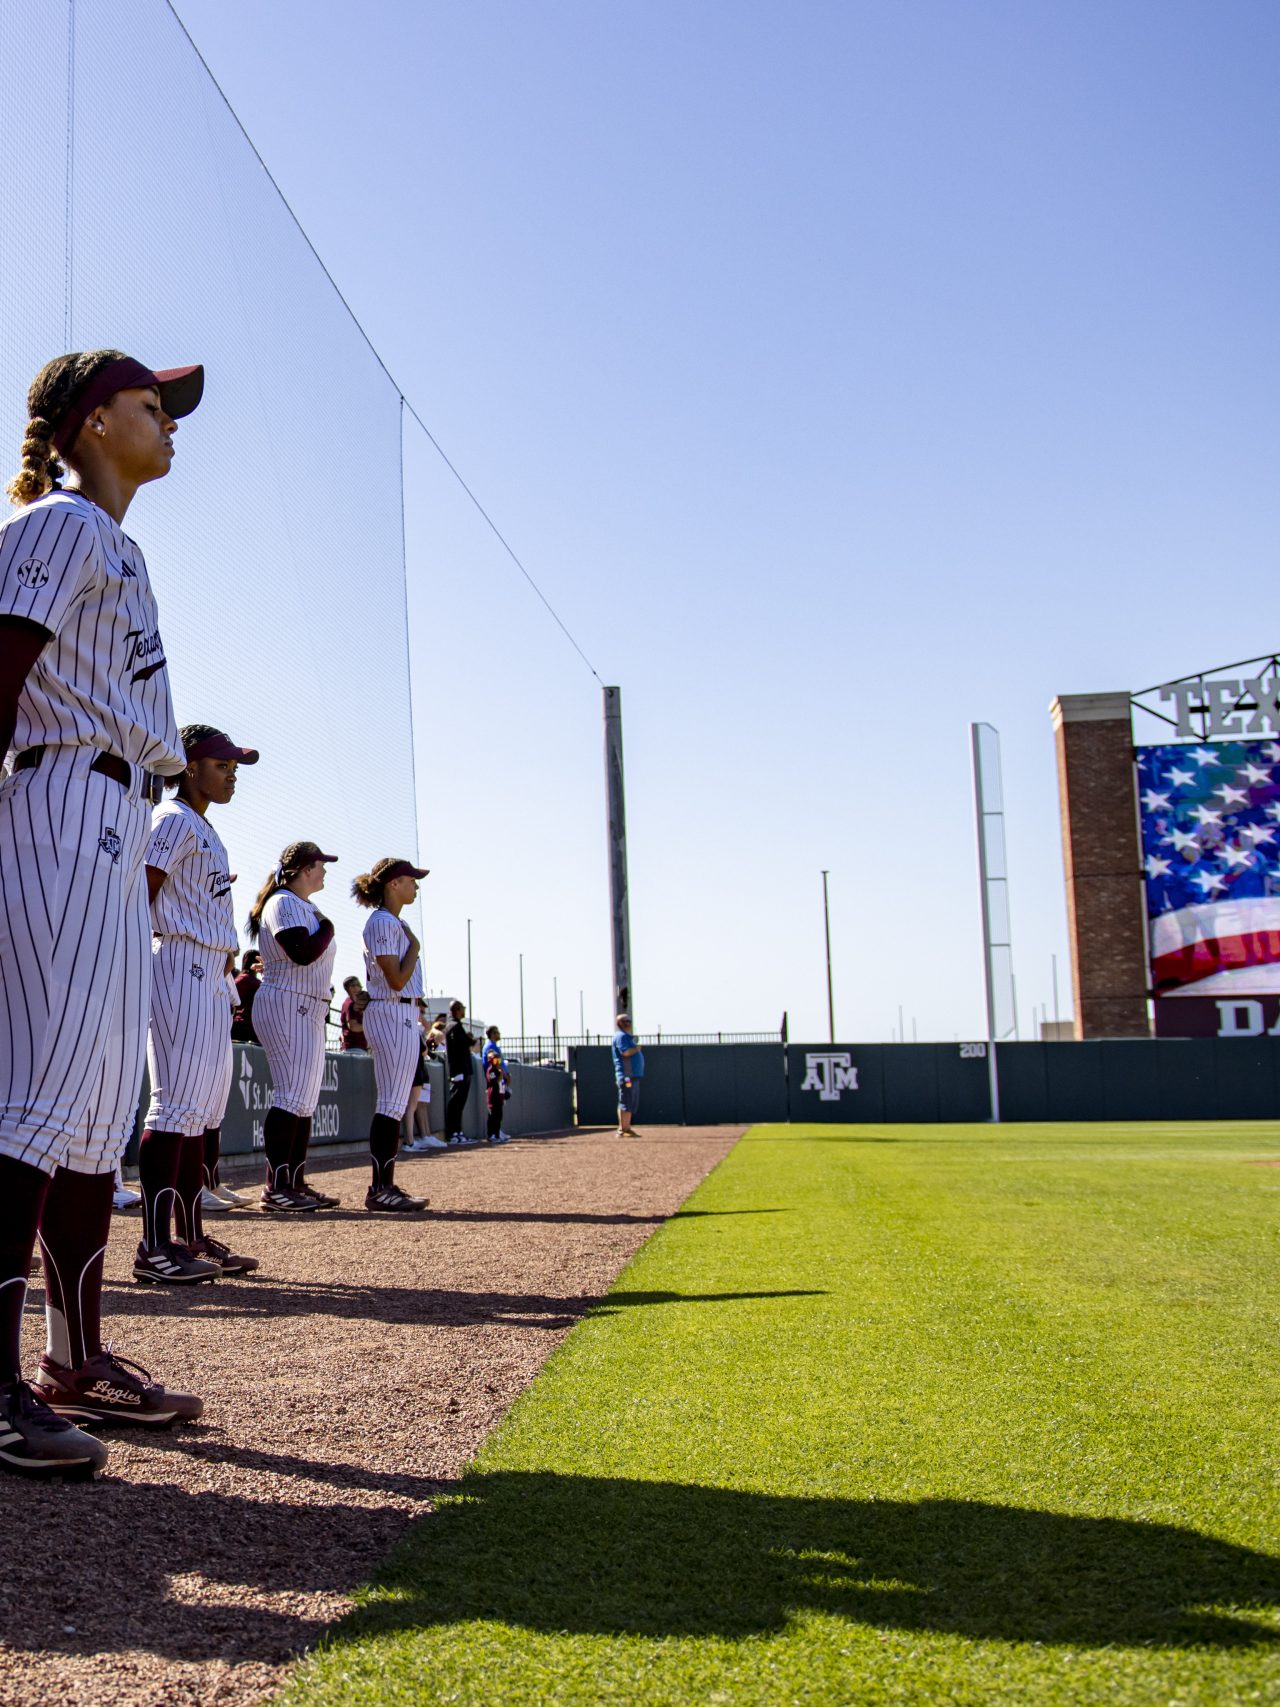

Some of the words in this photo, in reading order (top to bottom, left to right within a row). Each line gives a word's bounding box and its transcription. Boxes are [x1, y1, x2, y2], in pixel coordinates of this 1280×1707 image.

[18, 559, 49, 588] SEC
[154, 838, 169, 853] SEC
[960, 1043, 986, 1058] 200
[253, 1082, 263, 1110] St.
[92, 1380, 141, 1405] Aggies
